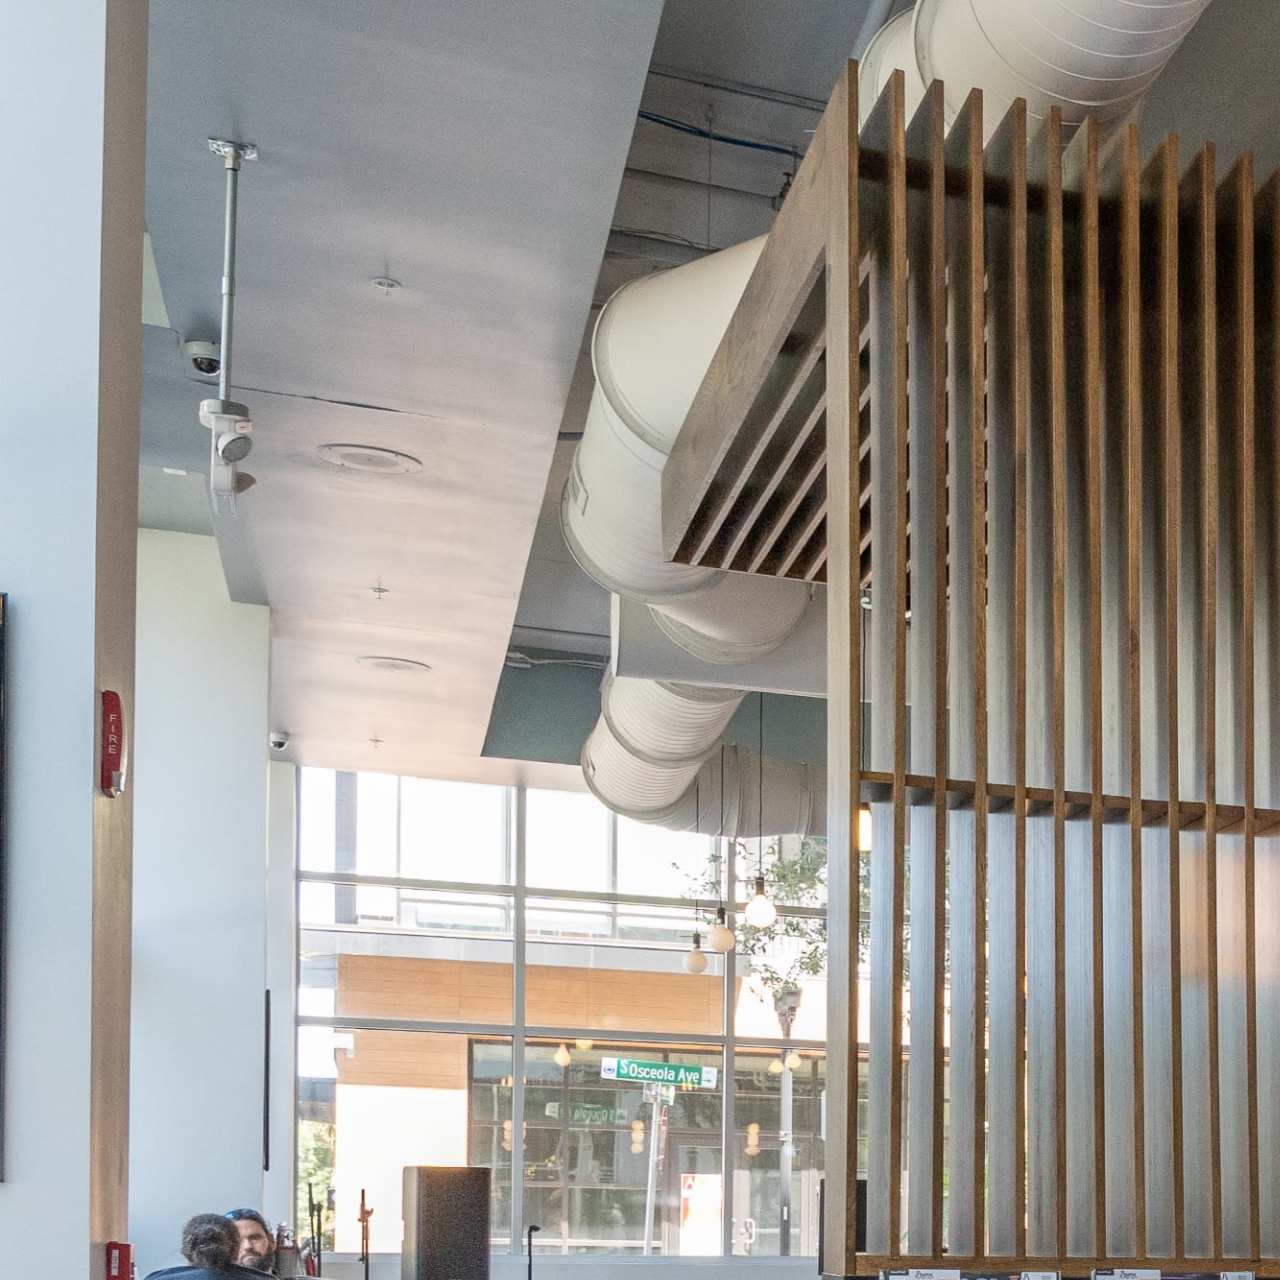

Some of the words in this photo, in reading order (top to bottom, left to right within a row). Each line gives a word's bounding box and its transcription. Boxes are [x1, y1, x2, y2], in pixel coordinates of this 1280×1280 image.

[109, 714, 118, 753] FIRE
[620, 1058, 629, 1073] S
[629, 1063, 675, 1081] Osceola
[677, 1068, 700, 1083] Ave
